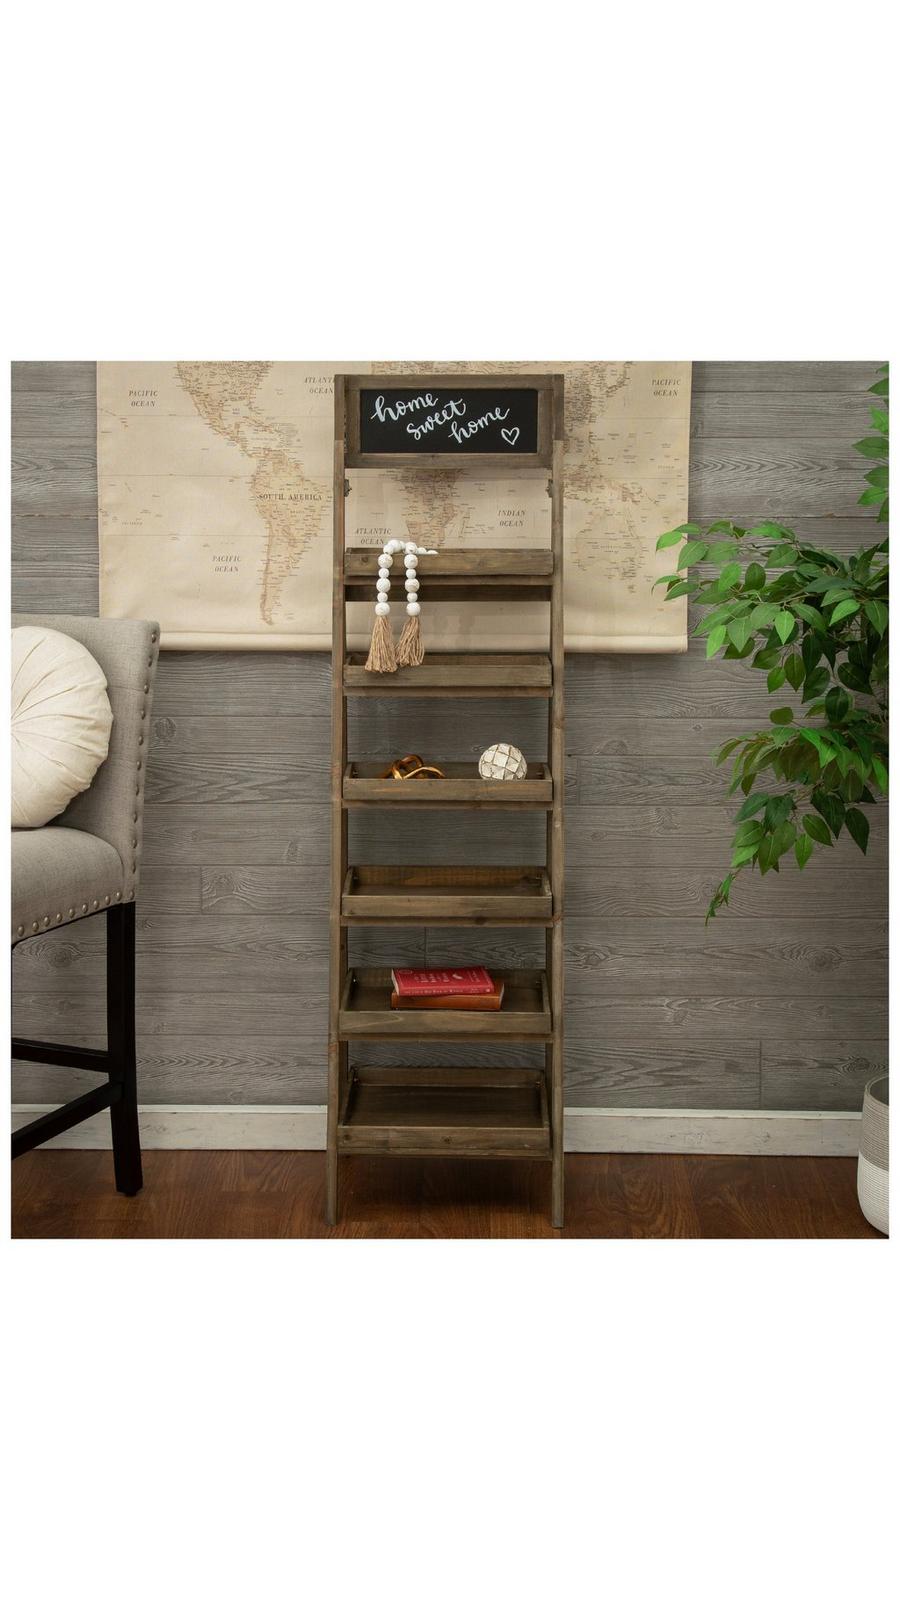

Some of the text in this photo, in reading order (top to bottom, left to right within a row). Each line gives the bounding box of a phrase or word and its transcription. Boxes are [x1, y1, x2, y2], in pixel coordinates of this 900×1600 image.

[304, 376, 334, 384] ATLANTI
[128, 389, 159, 397] PACIFIC
[130, 400, 156, 408] OCEAN
[370, 392, 439, 423] home
[406, 398, 467, 441] sweet
[448, 407, 511, 444] home
[258, 493, 323, 501] SOUTH AMERICA
[211, 555, 242, 563] PACIFIC
[214, 565, 240, 573] OCEAN
